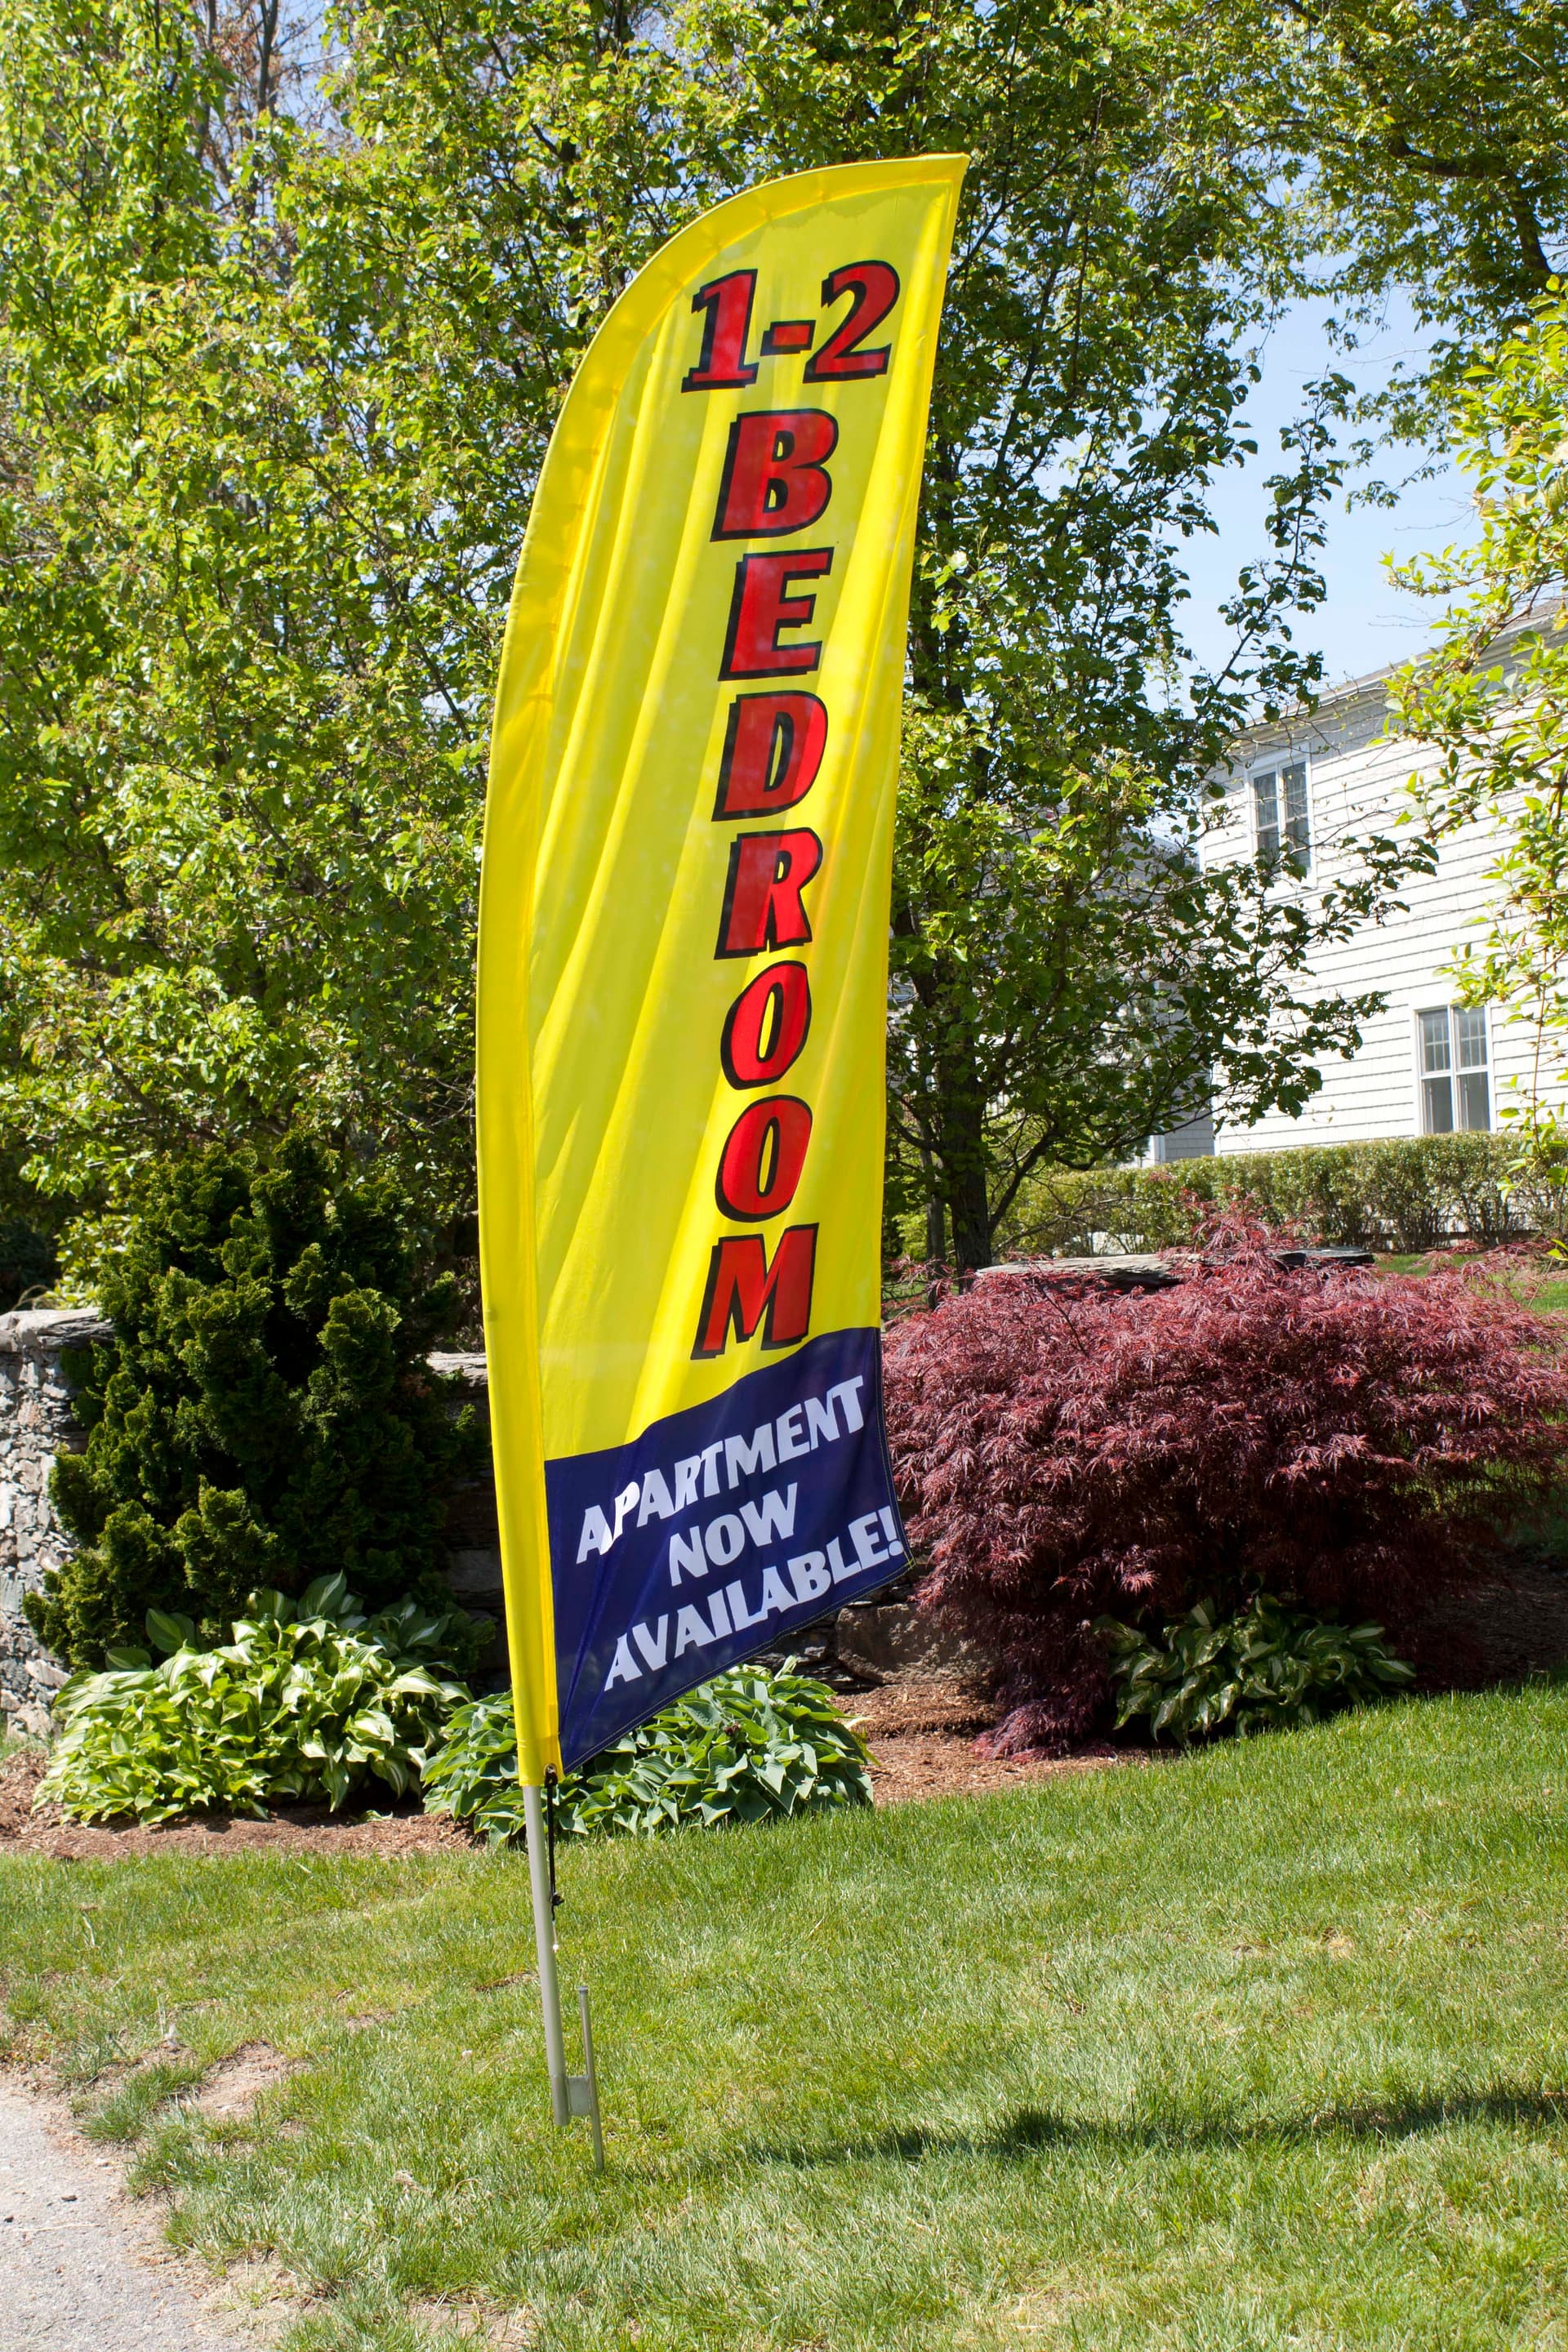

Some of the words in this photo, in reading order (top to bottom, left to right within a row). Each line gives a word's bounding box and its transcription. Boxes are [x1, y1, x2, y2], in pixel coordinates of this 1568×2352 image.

[681, 260, 899, 394] 1-2
[692, 408, 840, 1361] BEDROOM
[576, 1375, 864, 1564] APARTMENT
[669, 1482, 797, 1587] NOW
[604, 1505, 904, 1692] AVAILABLE!
